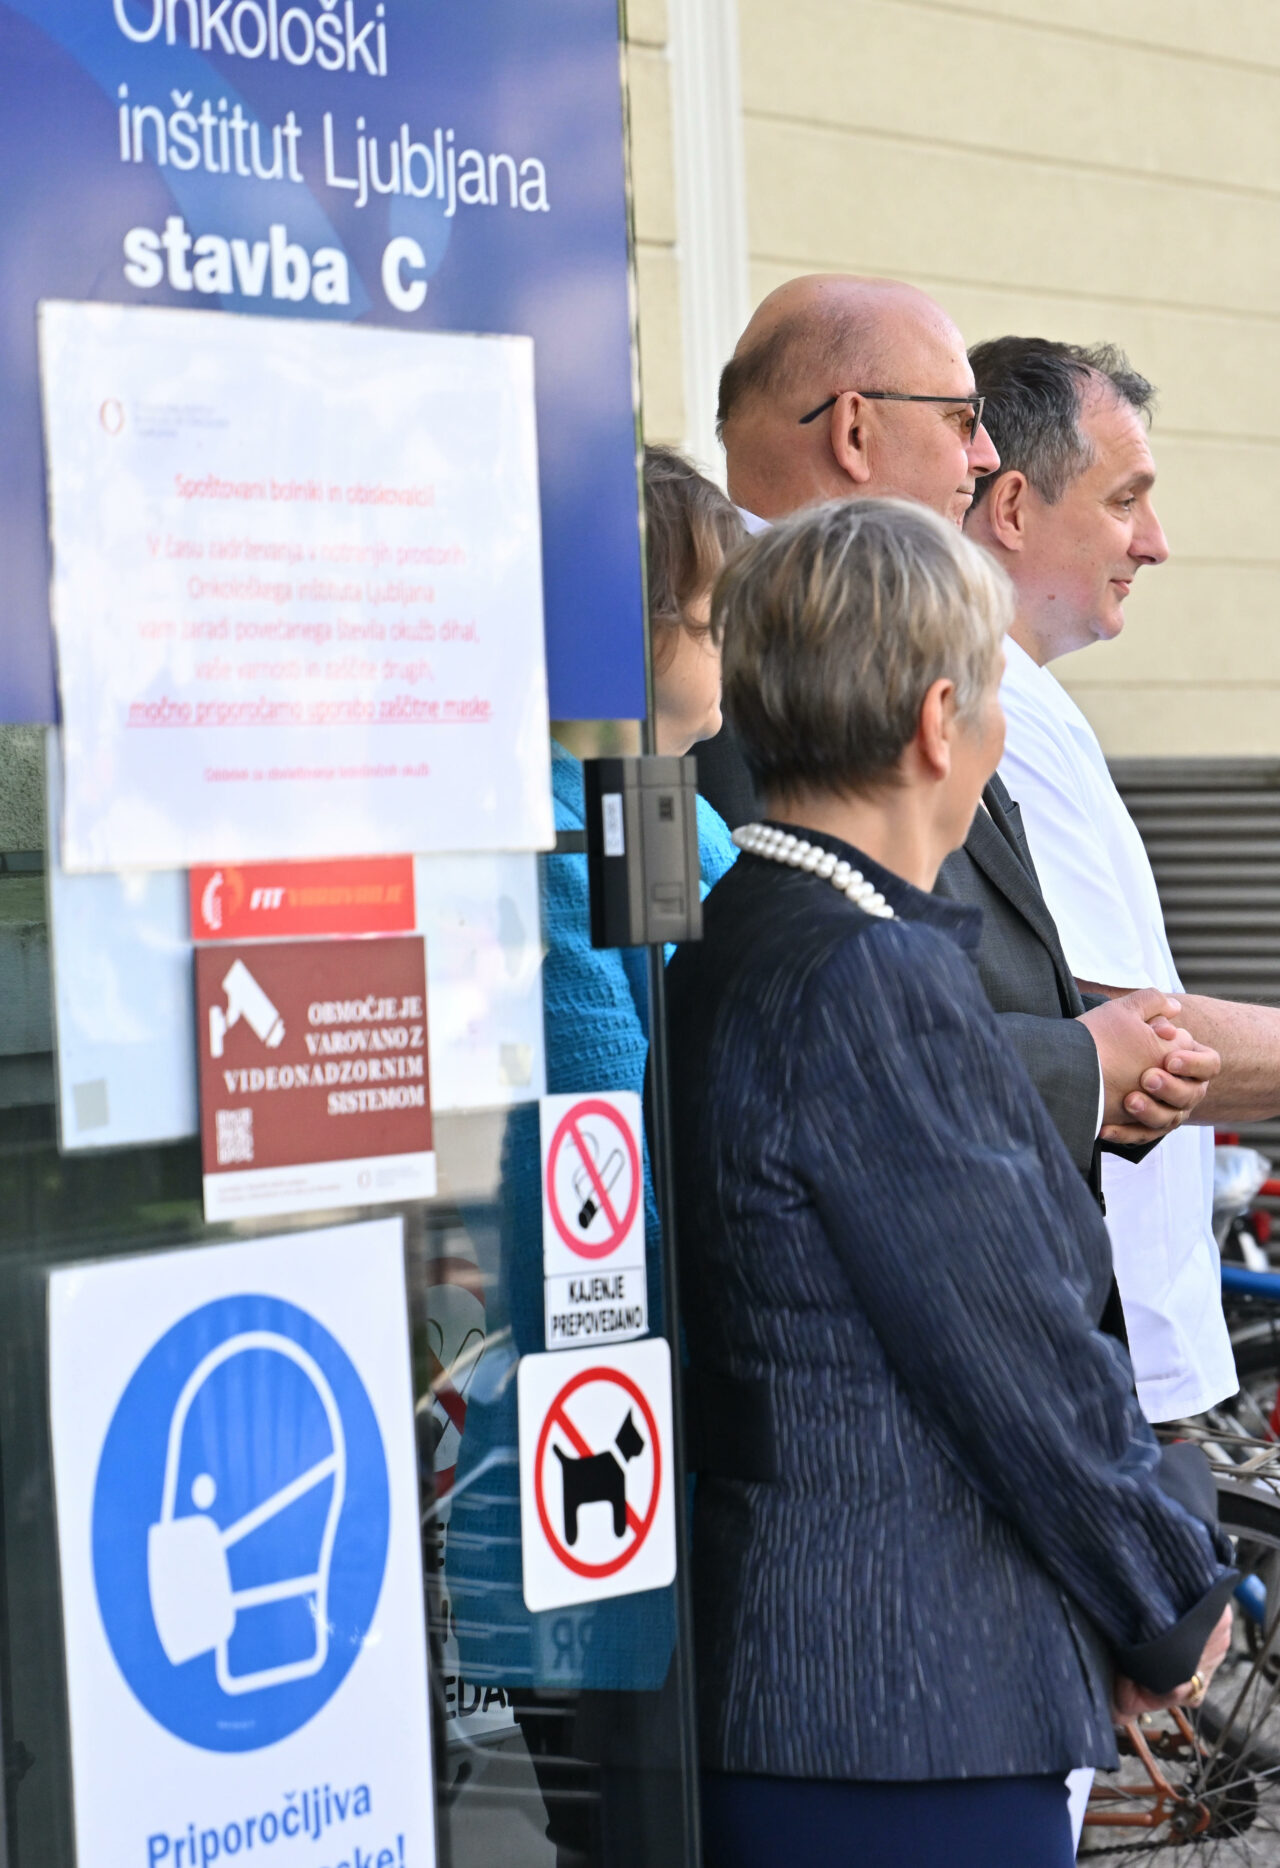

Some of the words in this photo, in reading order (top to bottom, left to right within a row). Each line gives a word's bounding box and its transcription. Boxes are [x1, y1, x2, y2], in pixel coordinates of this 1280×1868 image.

[114, 0, 388, 77] Onkološki
[118, 84, 304, 183] inštitut
[323, 112, 551, 217] Ljubljana
[123, 216, 350, 305] stavba
[381, 236, 428, 312] C
[307, 994, 398, 1027] OBMOČJE
[400, 995, 424, 1019] JE
[304, 1027, 409, 1056] VAROVANO
[409, 1025, 425, 1048] Z
[222, 1054, 425, 1094] VIDEONADZORNIM
[327, 1084, 426, 1116] SISTEMOM
[568, 1275, 626, 1304] KAJENJE
[552, 1306, 644, 1339] PREPOVEDANO
[146, 1783, 372, 1868] Priporočljiva
